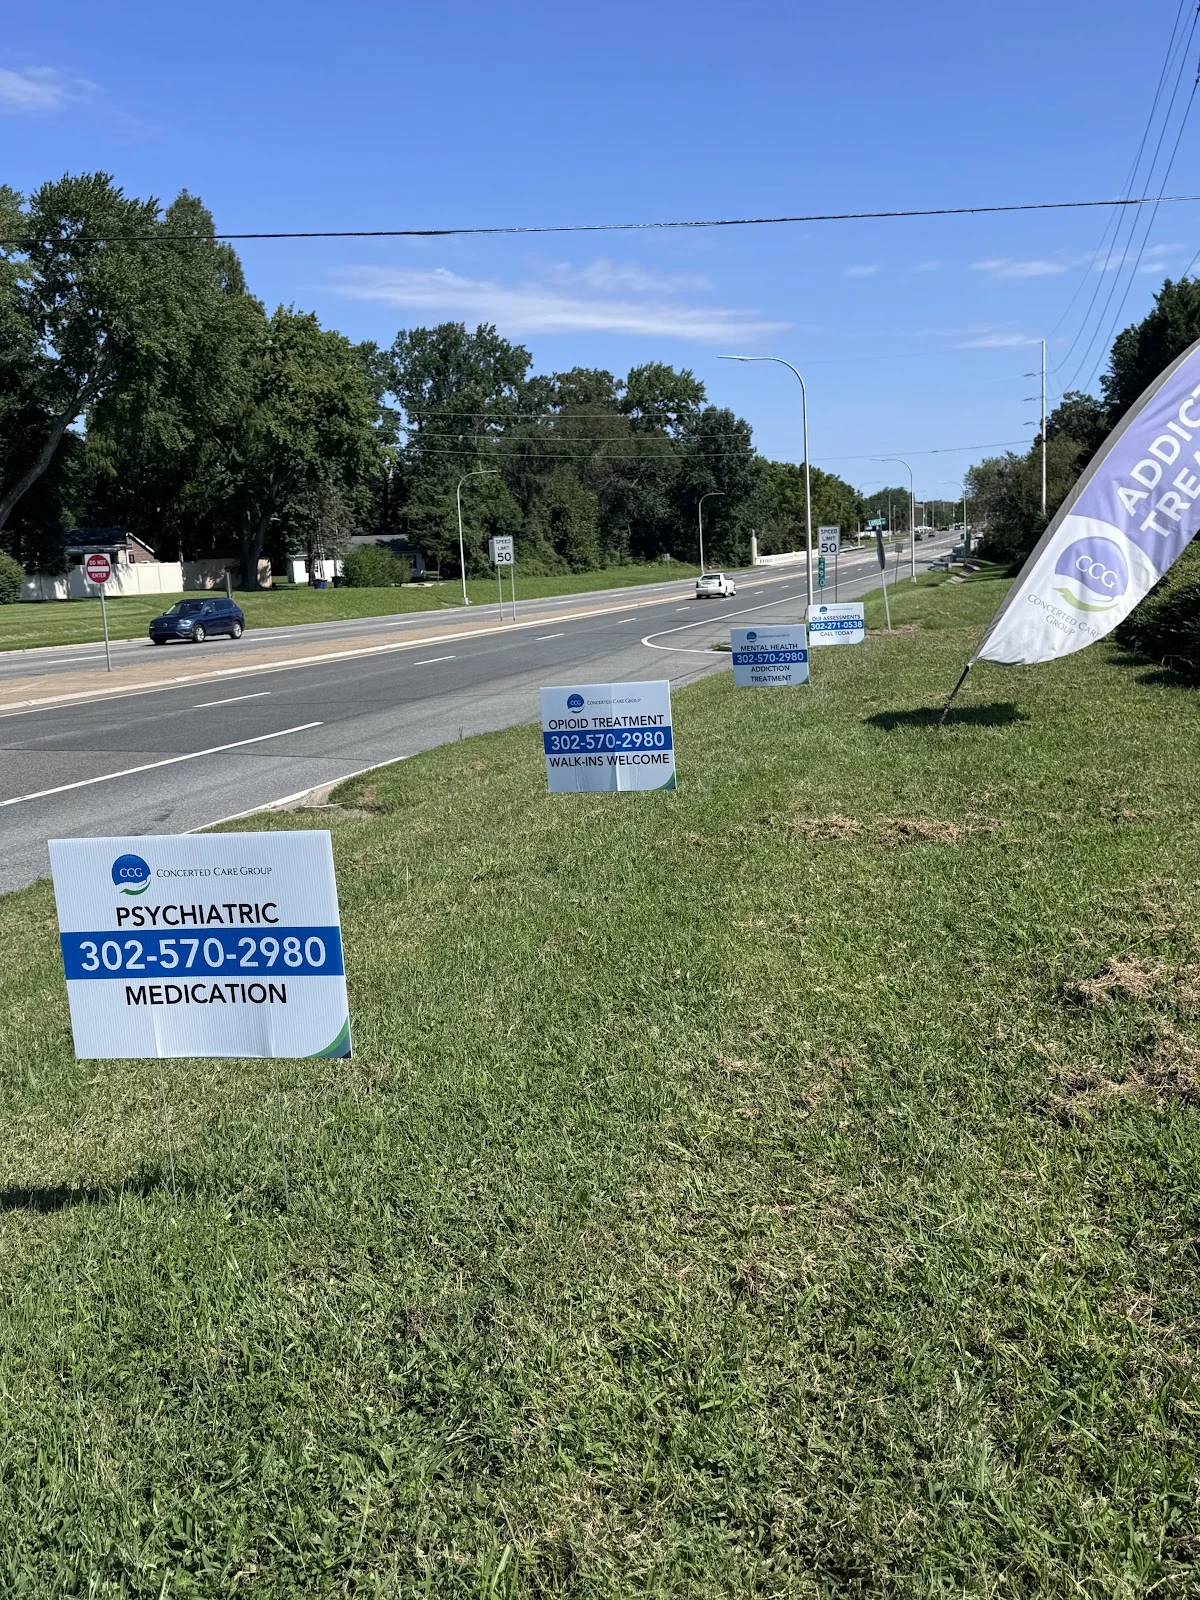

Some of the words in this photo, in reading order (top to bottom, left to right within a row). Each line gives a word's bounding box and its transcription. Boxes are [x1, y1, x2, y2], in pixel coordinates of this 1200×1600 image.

[1139, 450, 1200, 537] TRE
[822, 543, 836, 552] 50
[498, 553, 511, 561] 50
[1076, 556, 1117, 588] CCG
[1028, 594, 1077, 626] CONCERTED
[811, 621, 862, 630] 302-271-0538
[1046, 615, 1075, 635] GROUP
[737, 652, 803, 663] 302-570-2980
[549, 719, 588, 729] OPIOID
[592, 715, 664, 727] TREATMENT
[551, 732, 664, 750] 302-570-2980
[549, 756, 603, 767] WALK-INS
[607, 754, 669, 766] WELCOME
[120, 868, 142, 877] CCG
[156, 869, 210, 878] CONCERTED
[214, 867, 238, 876] CARE
[240, 867, 272, 875] GROUP
[116, 903, 279, 926] PSYCHIATRIC
[80, 936, 326, 971] 302-570-2980
[126, 983, 287, 1006] MEDICATION
